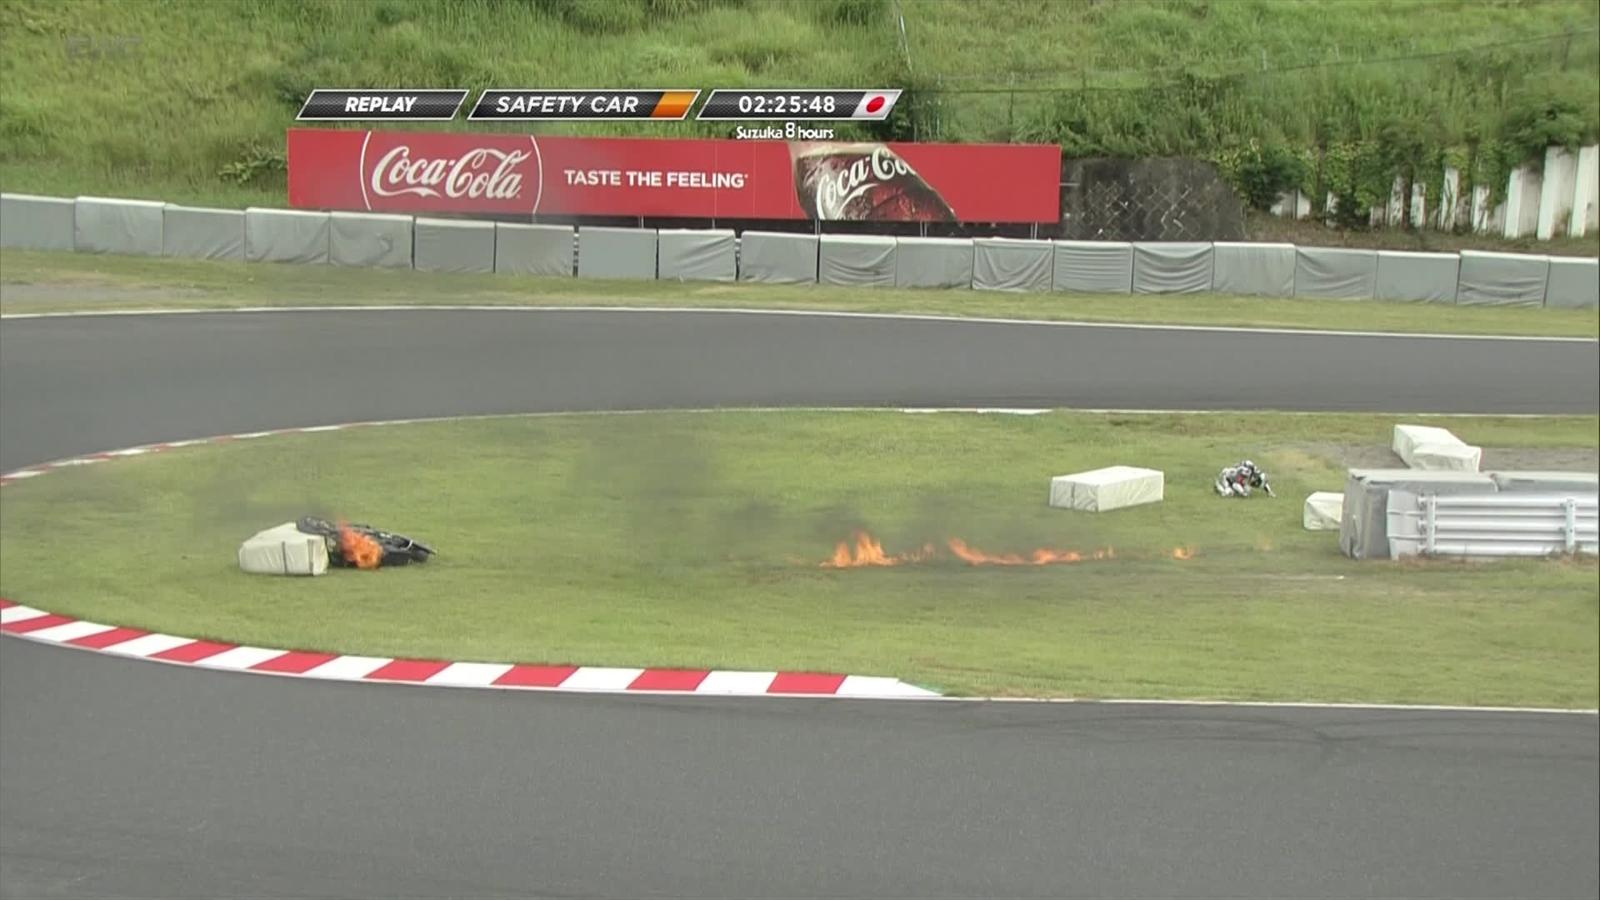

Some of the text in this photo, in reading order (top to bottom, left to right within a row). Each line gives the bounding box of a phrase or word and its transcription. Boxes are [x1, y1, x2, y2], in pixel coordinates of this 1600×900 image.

[371, 145, 532, 199] Coca-Cola
[564, 170, 745, 189] TASTE THE FEELING
